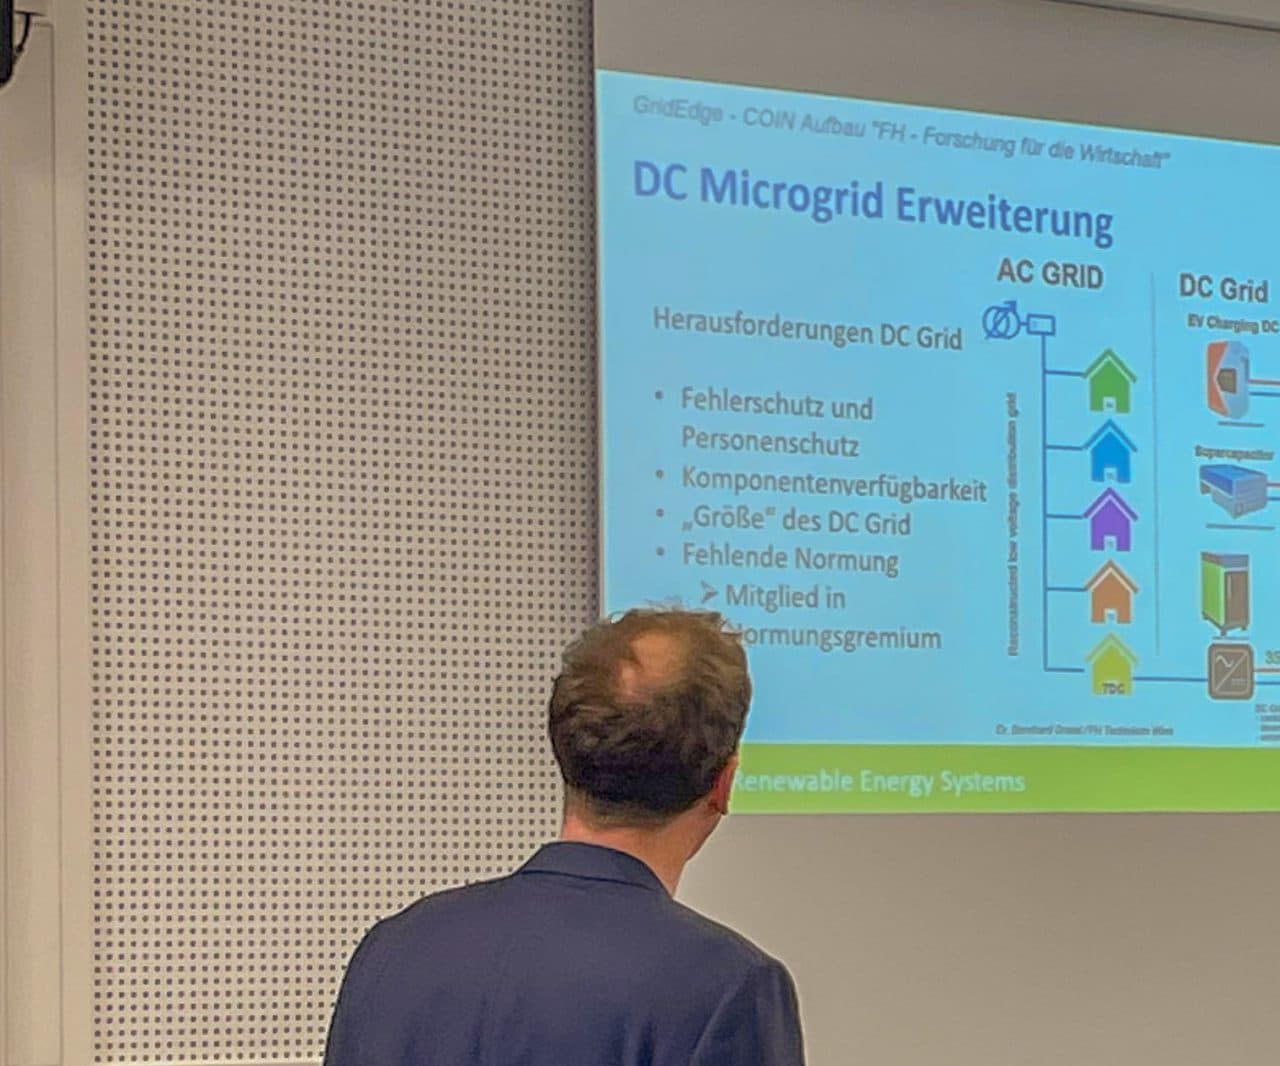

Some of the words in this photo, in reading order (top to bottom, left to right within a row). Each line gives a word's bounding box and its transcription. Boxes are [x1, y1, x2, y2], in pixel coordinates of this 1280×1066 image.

[633, 95, 723, 124] GridEdge
[743, 108, 796, 131] COIN
[801, 112, 866, 139] Aufbau
[923, 126, 1016, 157] Forschung
[1020, 136, 1044, 158] für
[1049, 139, 1074, 160] die
[633, 159, 688, 201] DC
[700, 166, 883, 224] Microgrid
[897, 186, 1114, 249] Erweiterung
[997, 256, 1034, 284] AC
[1042, 262, 1104, 289] GRID
[1179, 273, 1214, 299] DC
[1220, 277, 1269, 304] Grid
[653, 307, 874, 347] Herausforderungen
[880, 325, 910, 347] DC
[916, 327, 963, 351] Grid
[1206, 315, 1259, 335] Charging
[1261, 319, 1280, 334] DC
[681, 387, 825, 419] Fehlerschutz
[831, 396, 874, 420] und
[682, 426, 859, 458] Personenschutz
[682, 465, 988, 503] Komponentenverfügbarkeit
[783, 509, 822, 533] des
[828, 511, 859, 534] DC
[865, 512, 911, 536] Grid
[683, 542, 787, 570] Fehlende
[795, 547, 898, 577] Normung
[725, 583, 819, 614] Mitglied
[826, 586, 846, 610] in
[860, 770, 934, 798] Energy
[941, 770, 1026, 795] Systems
